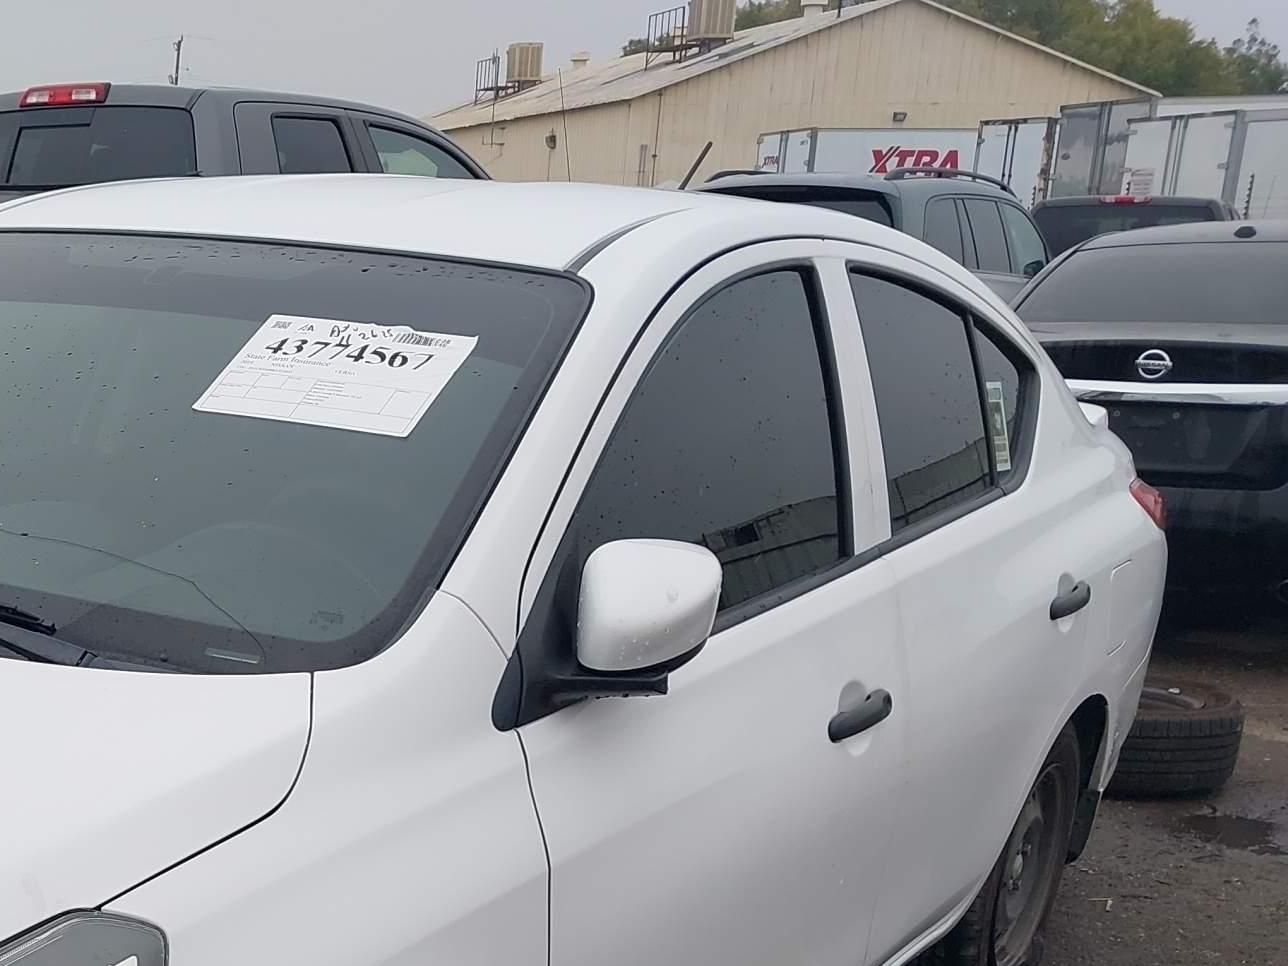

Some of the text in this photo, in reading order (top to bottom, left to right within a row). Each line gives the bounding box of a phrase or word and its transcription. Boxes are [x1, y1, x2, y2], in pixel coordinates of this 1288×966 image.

[868, 145, 959, 174] XTRA
[244, 352, 332, 367] State Farm Insurance
[264, 336, 435, 371] 43774567
